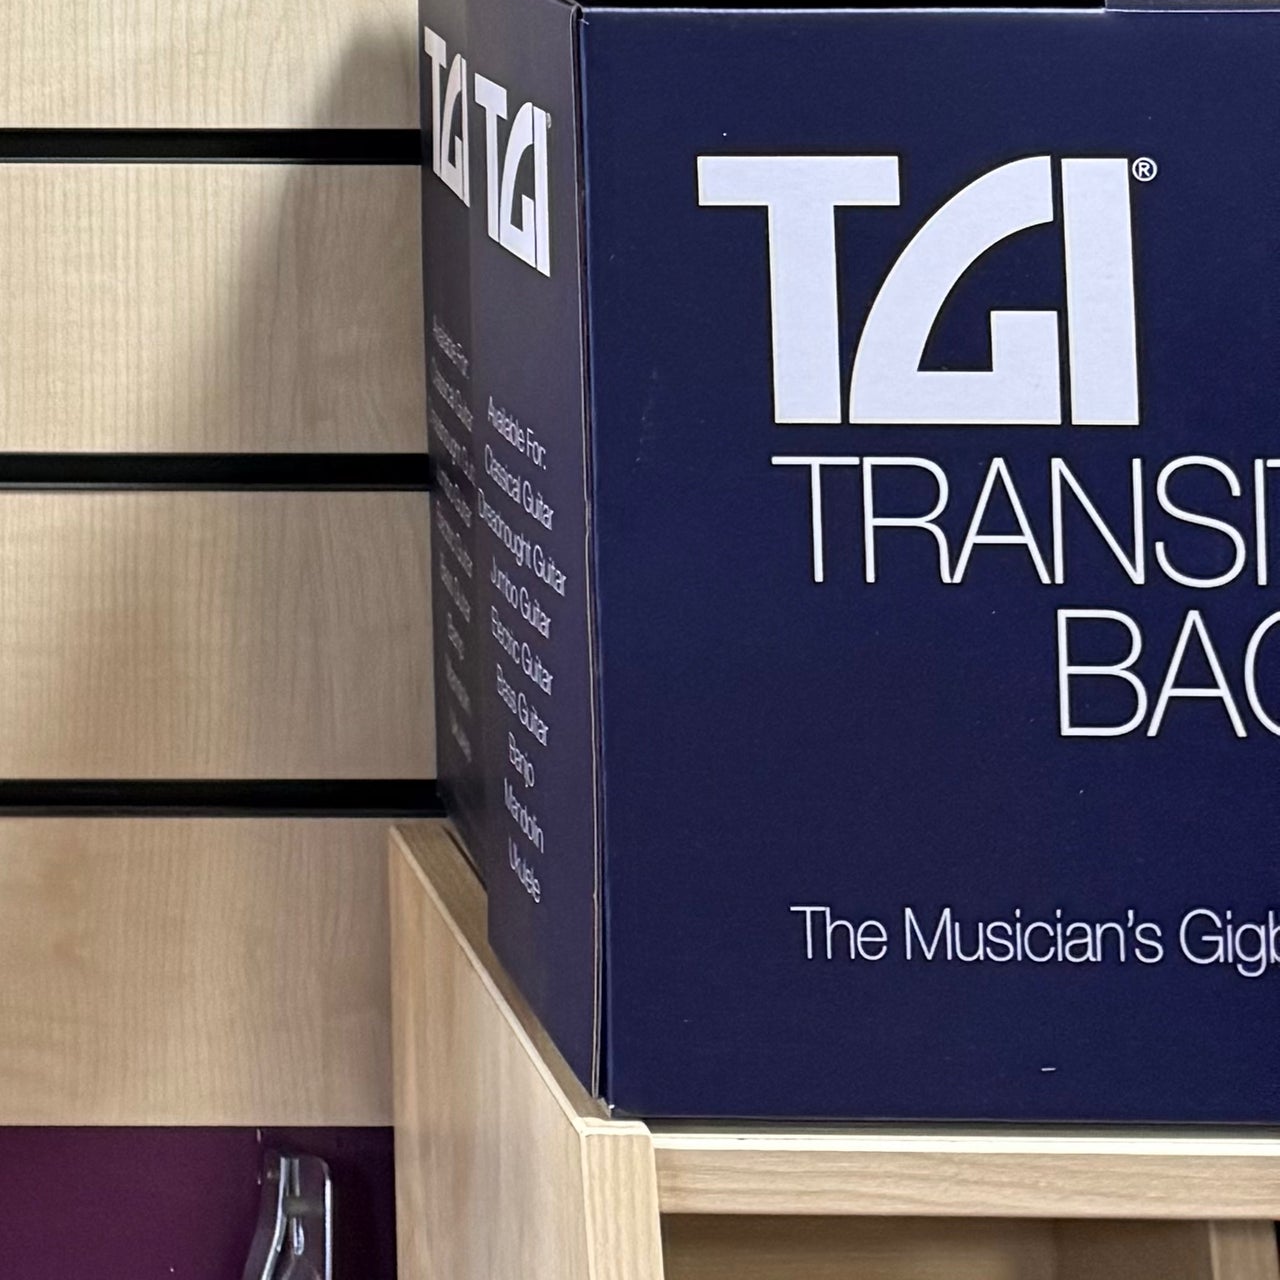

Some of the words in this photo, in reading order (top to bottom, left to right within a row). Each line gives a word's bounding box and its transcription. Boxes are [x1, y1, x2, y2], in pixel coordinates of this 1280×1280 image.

[423, 25, 470, 208] TGI
[771, 454, 1280, 588] TRANSI
[1056, 608, 1280, 738] BA
[790, 906, 888, 960] The
